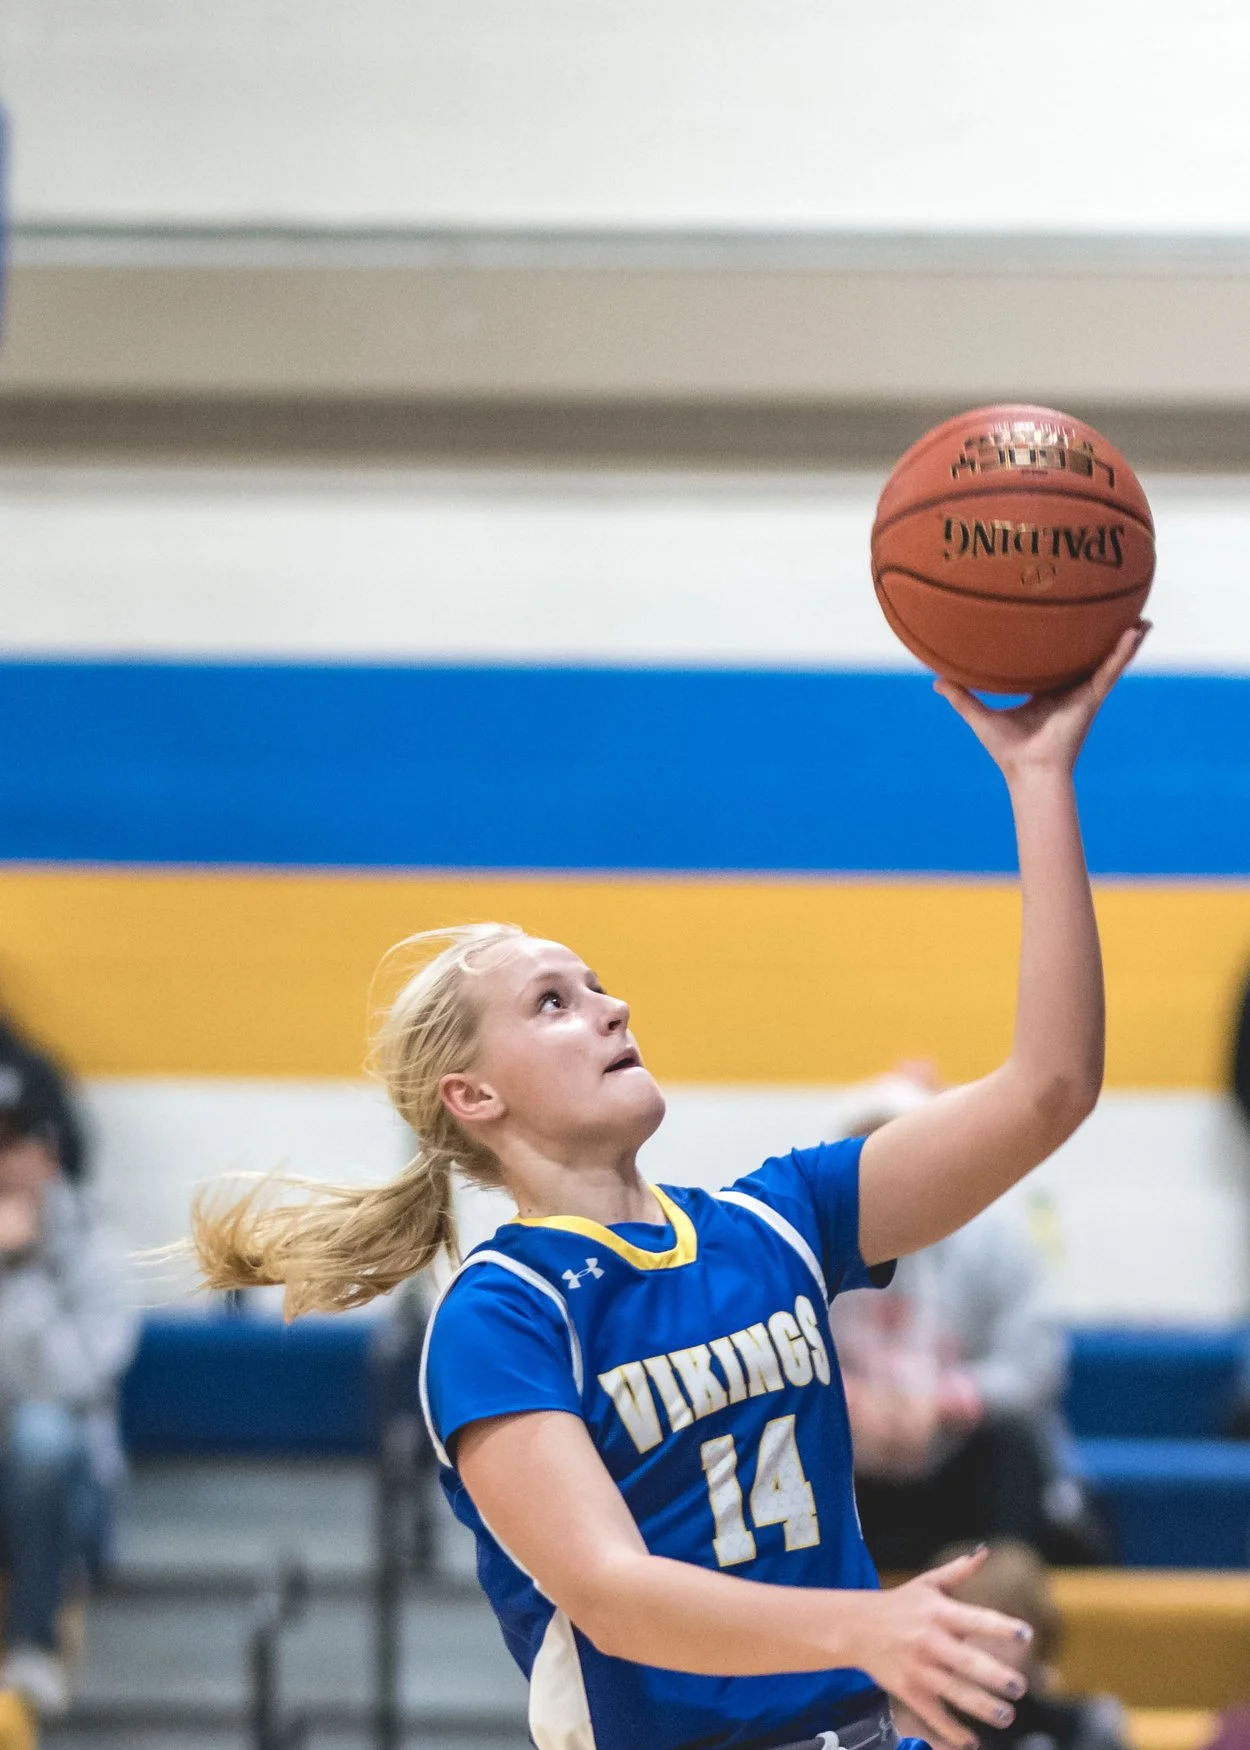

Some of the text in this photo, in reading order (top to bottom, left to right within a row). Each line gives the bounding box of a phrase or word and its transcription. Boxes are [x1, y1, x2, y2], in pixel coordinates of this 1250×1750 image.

[943, 517, 1125, 569] SPALDING
[596, 1294, 831, 1455] VIKINGS
[700, 1413, 821, 1568] 14
